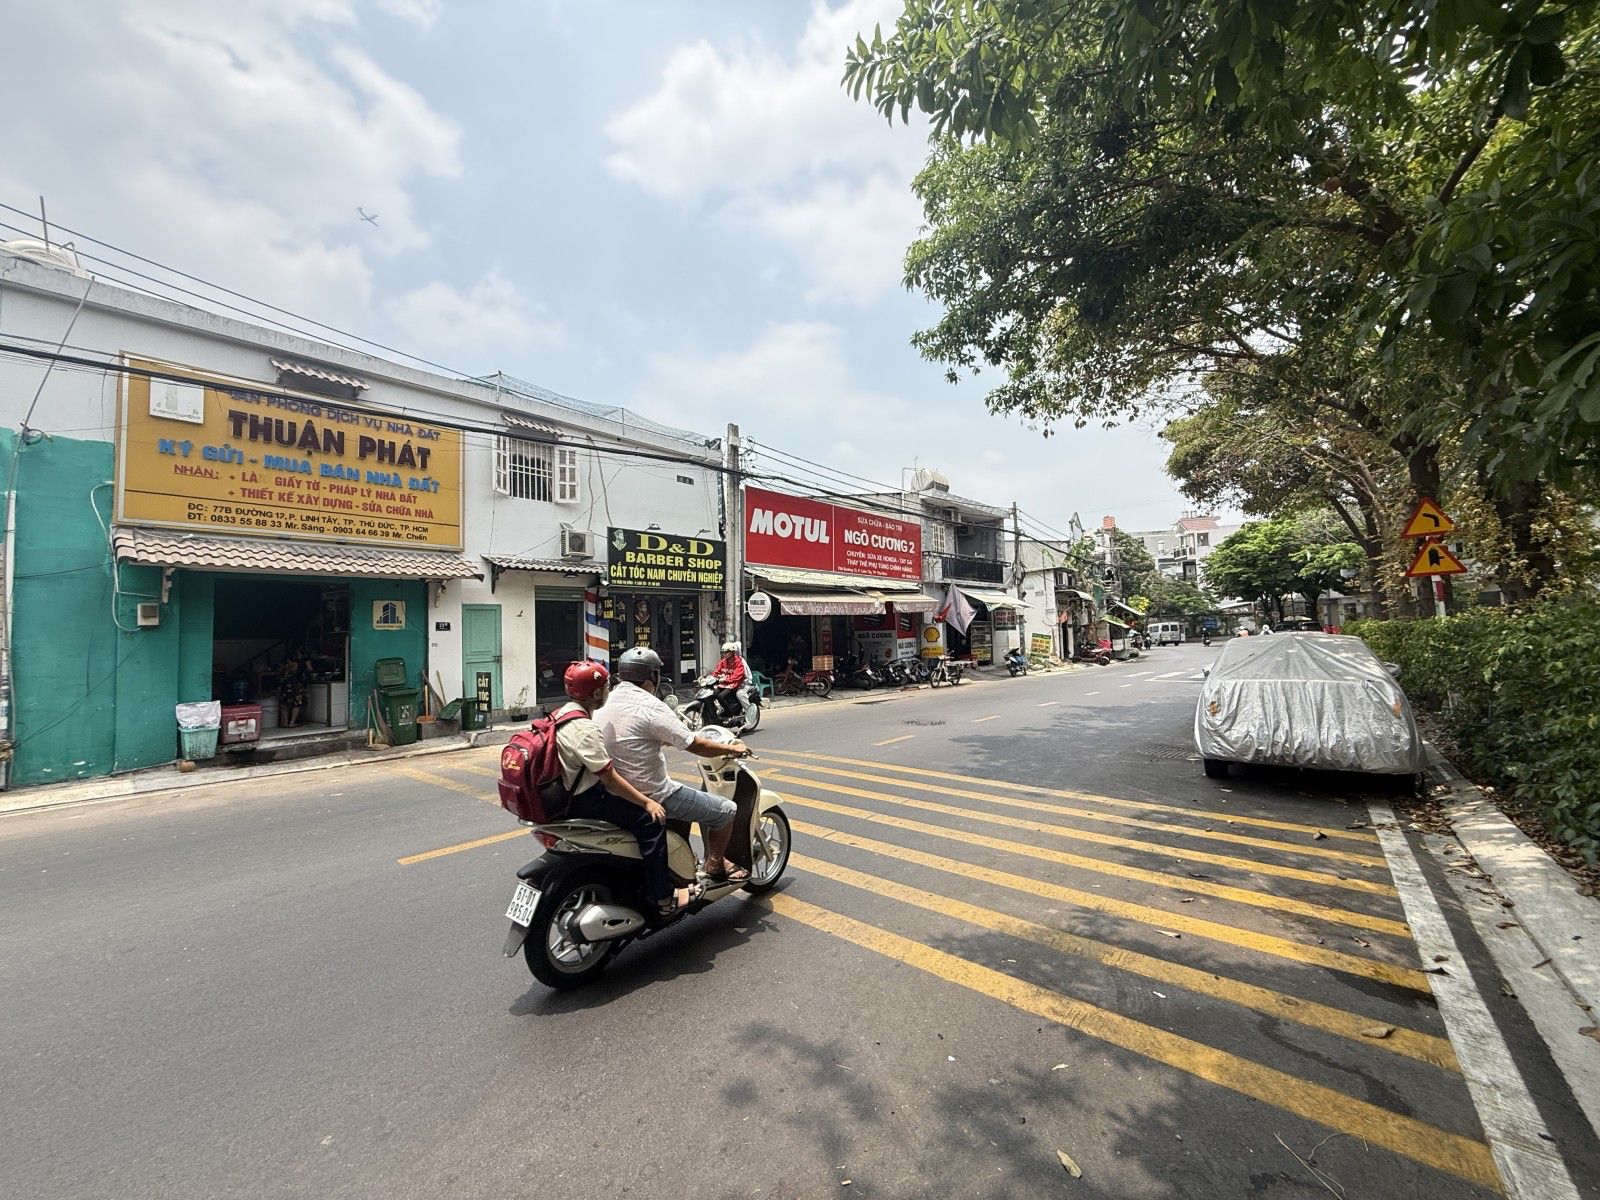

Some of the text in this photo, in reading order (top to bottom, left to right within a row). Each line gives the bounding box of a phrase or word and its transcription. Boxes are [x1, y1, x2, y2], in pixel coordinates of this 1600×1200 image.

[228, 409, 431, 470] THUẬN PHÁT
[364, 416, 383, 431] VỤ
[387, 418, 414, 437] NHÀ
[157, 439, 194, 457] KÝ
[202, 444, 245, 464] GỬI
[263, 455, 312, 474] MUA
[319, 463, 360, 481] BÁN
[366, 471, 403, 488] NHÀ
[408, 475, 440, 494] ĐẤT
[241, 487, 274, 501] THIẾT
[278, 489, 294, 503] KẾ
[297, 494, 320, 506] XÂY
[322, 497, 353, 510] DỰNG
[362, 500, 383, 513] SỬA
[386, 505, 411, 517] CHỮA
[415, 508, 434, 519] NHÀ
[275, 476, 303, 488] GIẤY
[306, 480, 320, 491] TỜ
[329, 483, 358, 496] PHÁP
[361, 487, 372, 499] LÝ
[375, 490, 396, 501] NHÀ
[399, 492, 418, 504] ĐẤT
[187, 512, 207, 521] ĐT:
[210, 514, 236, 524] 0833
[240, 517, 252, 526] 55
[255, 519, 267, 527] 88
[270, 520, 282, 528] 33
[285, 522, 299, 530] Mr.
[301, 522, 325, 533] Sáng
[333, 526, 353, 535] 0903
[368, 528, 378, 536] 66
[380, 529, 390, 538] 39
[392, 531, 403, 539] Mr.
[406, 531, 428, 541] Chiến
[188, 502, 208, 512] ĐC:
[213, 505, 232, 514] 77B
[235, 507, 273, 518] ĐƯỜNG
[300, 514, 320, 523] LINH
[321, 515, 340, 525] TÂY,
[377, 521, 397, 530] ĐỨC,
[413, 525, 428, 533] HCM
[750, 508, 830, 544] MOTUL
[636, 532, 714, 556] D&D
[844, 529, 869, 546] NGÔ
[909, 541, 915, 554] 2
[610, 561, 723, 585] CẮT TÓC NAM CHUYÊN NGHIỆP
[625, 551, 722, 570] BARBER SHOP
[478, 689, 489, 701] TÓC
